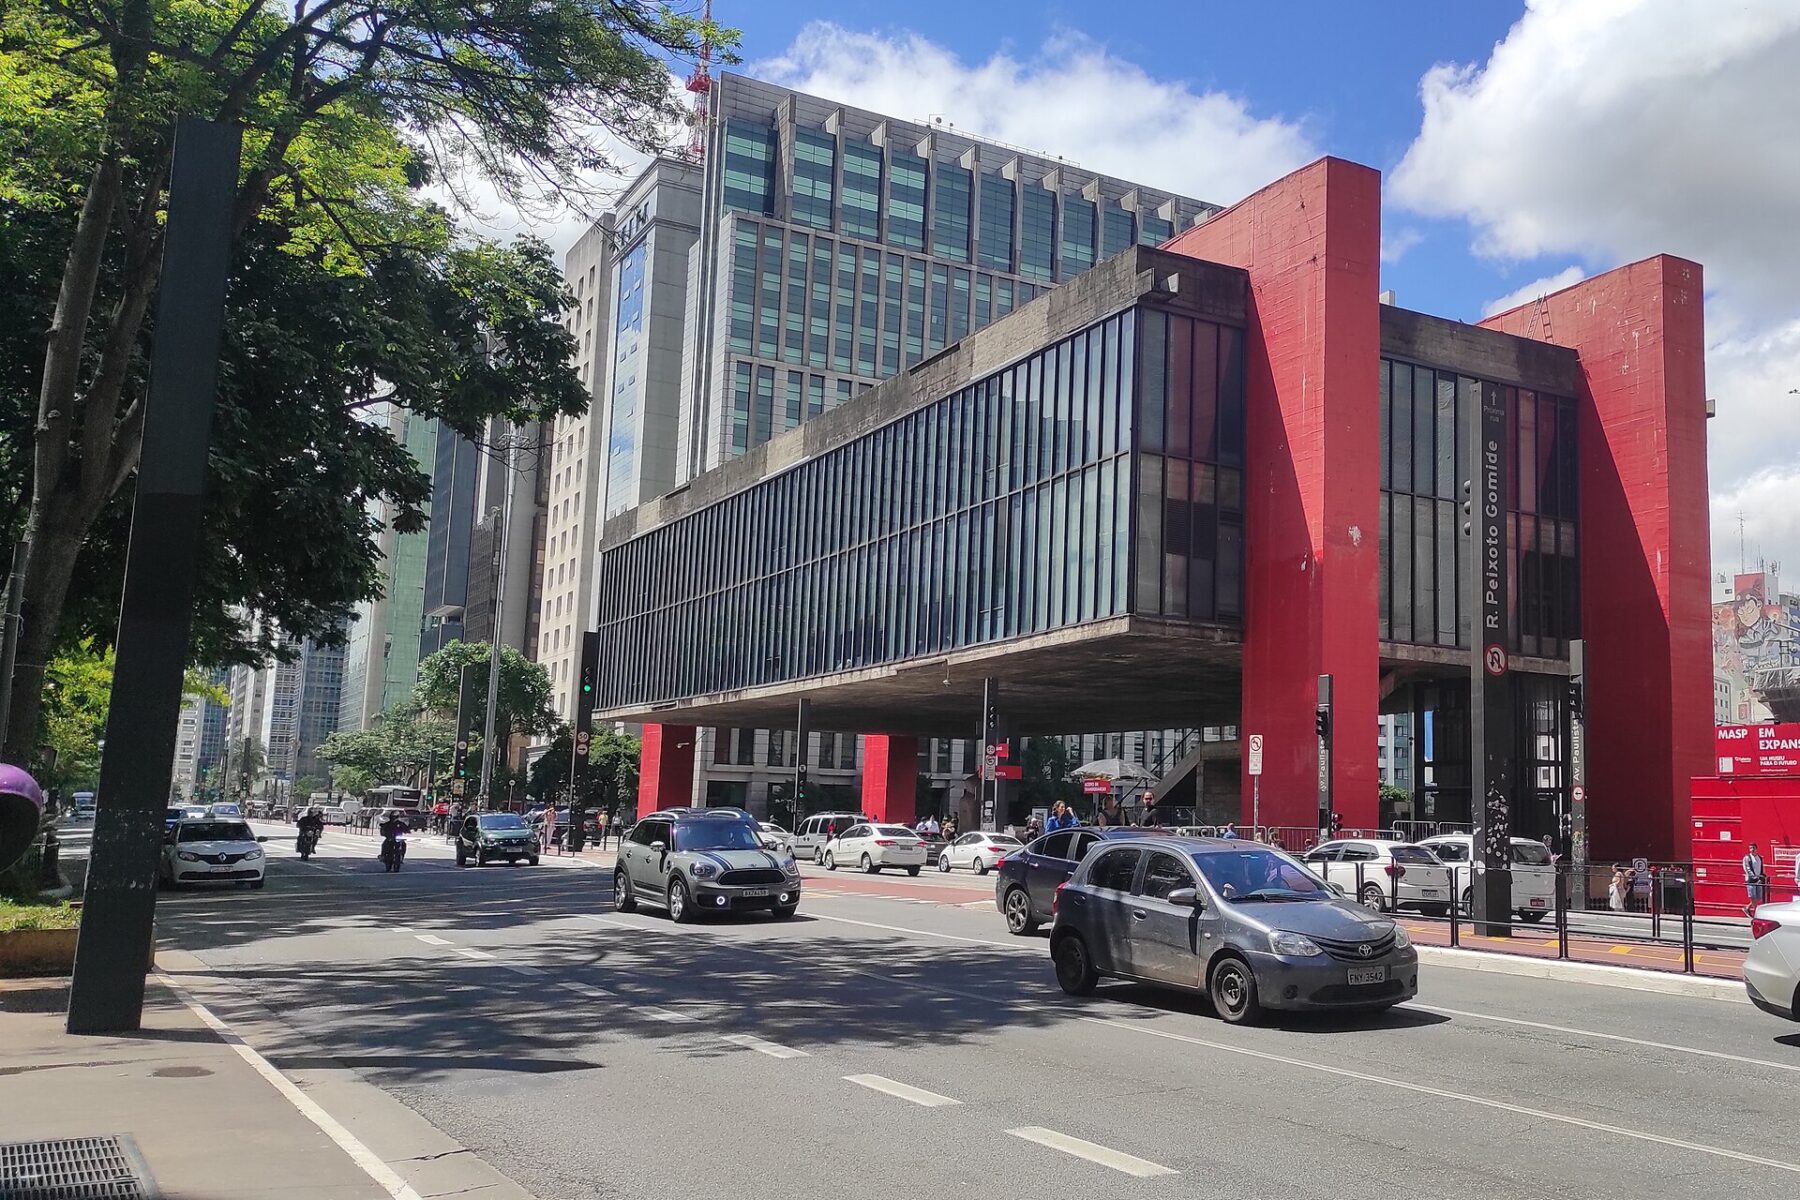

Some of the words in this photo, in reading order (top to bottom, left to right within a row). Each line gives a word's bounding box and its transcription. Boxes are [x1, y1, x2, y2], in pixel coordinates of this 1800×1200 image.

[1485, 440, 1498, 518] Gomide
[1485, 525, 1499, 605] Peixoto
[1486, 611, 1499, 629] R.
[1571, 719, 1580, 763] Paulista
[1718, 728, 1748, 739] MASP
[1758, 727, 1775, 738] EM
[1572, 766, 1580, 781] Av.
[1365, 971, 1383, 982] 3542
